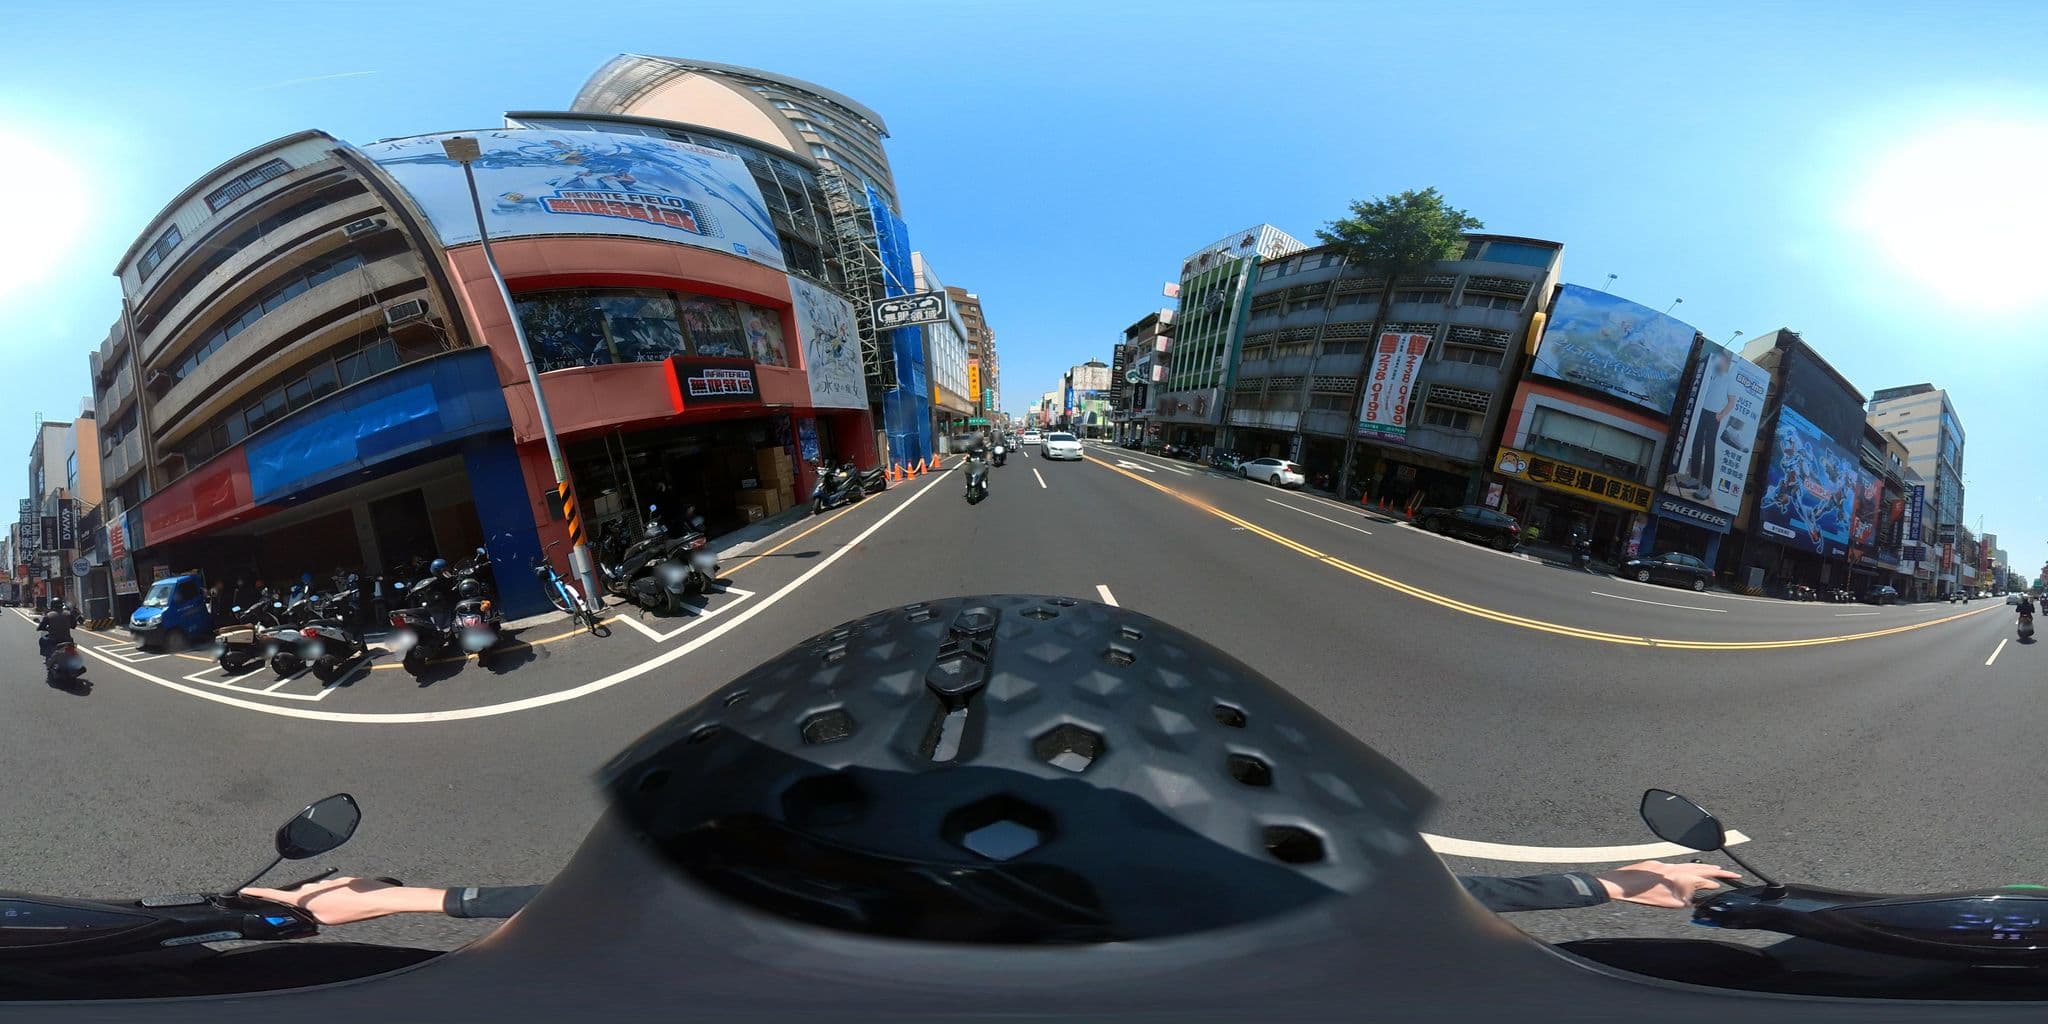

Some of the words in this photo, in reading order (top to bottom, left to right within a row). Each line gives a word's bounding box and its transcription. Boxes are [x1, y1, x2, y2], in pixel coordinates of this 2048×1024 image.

[562, 191, 625, 201] INFINITE
[627, 194, 683, 208] FIELD
[690, 378, 754, 395] 無限領域
[1661, 501, 1728, 527] SKECHERS
